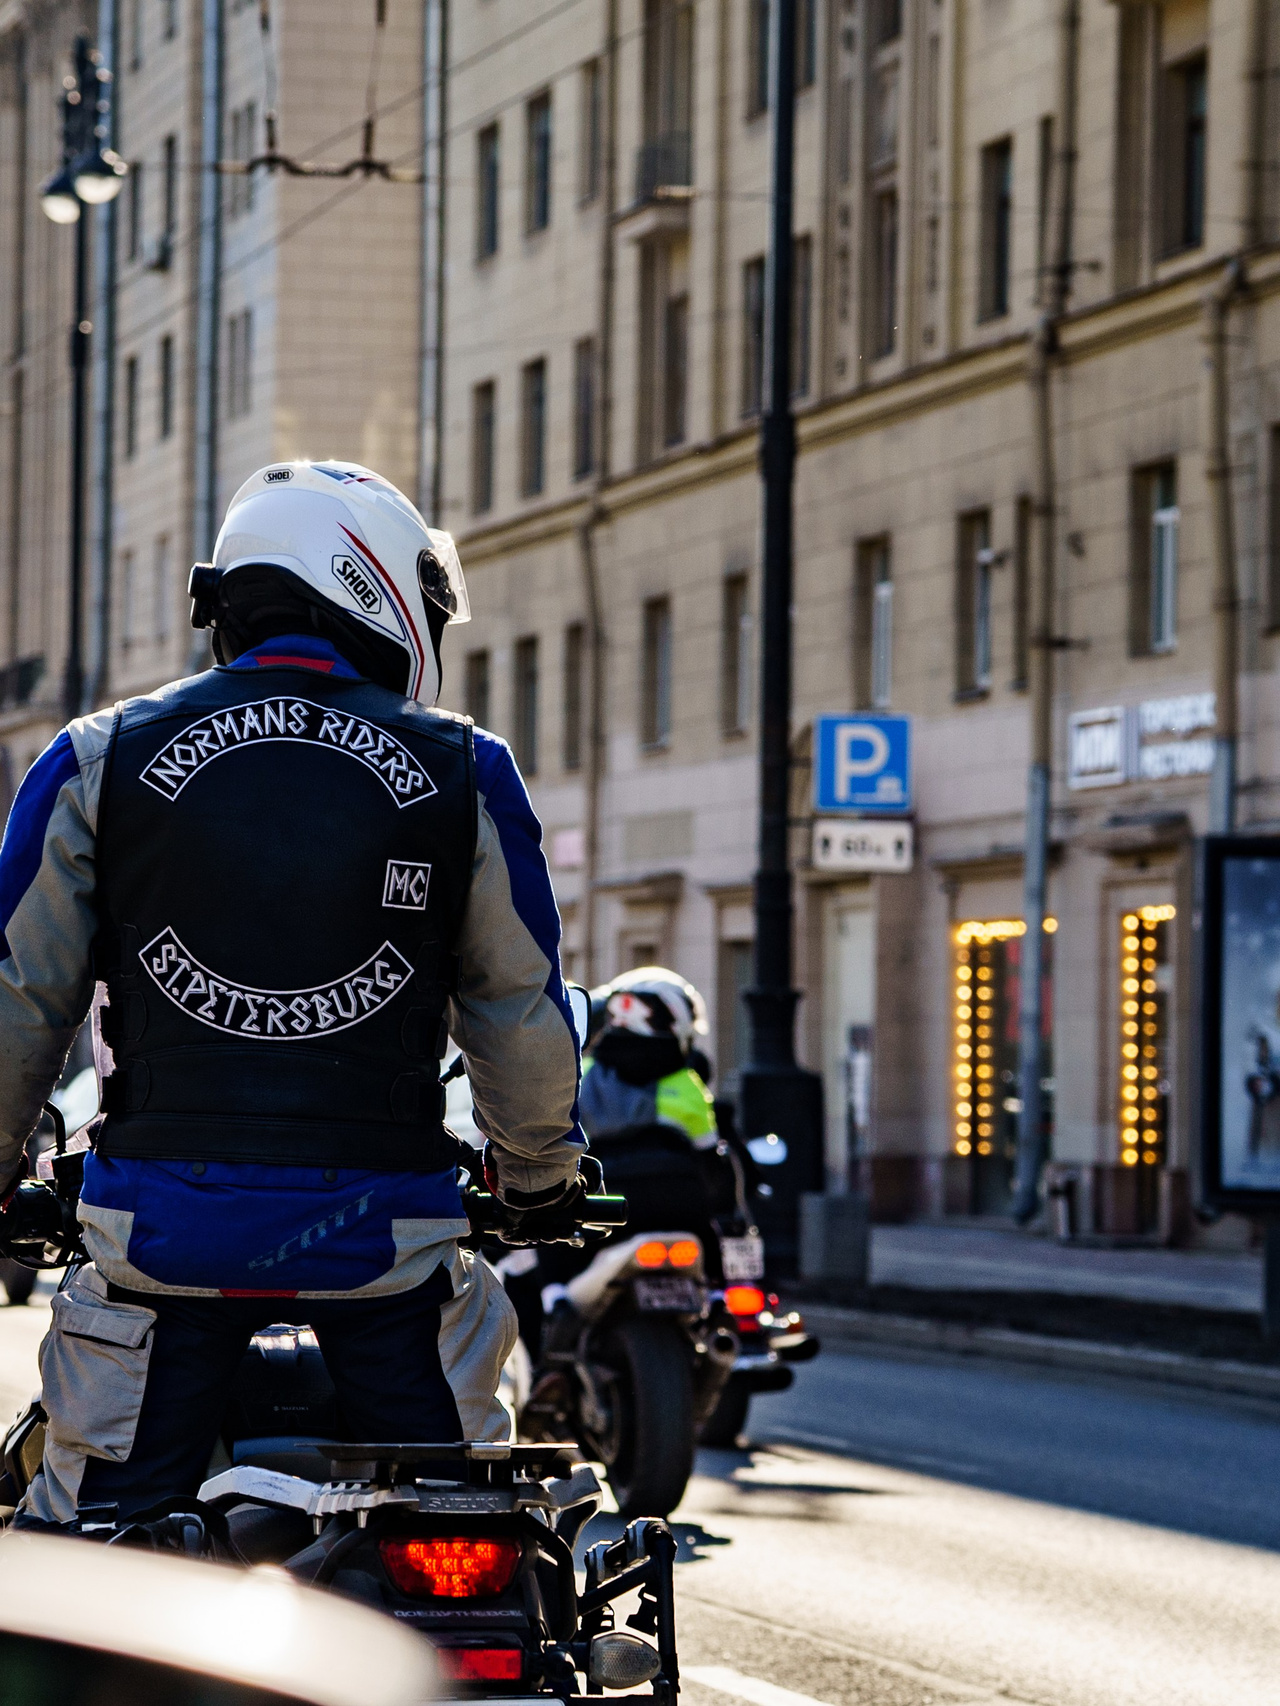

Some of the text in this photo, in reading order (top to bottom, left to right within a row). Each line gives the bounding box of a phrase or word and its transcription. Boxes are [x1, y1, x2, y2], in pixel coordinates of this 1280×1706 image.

[267, 470, 290, 482] SHOEI
[335, 560, 380, 610] SHOEI
[150, 700, 424, 794] NORMANS RIDERS
[388, 866, 426, 904] MC
[428, 1497, 499, 1509] SUZUKI
